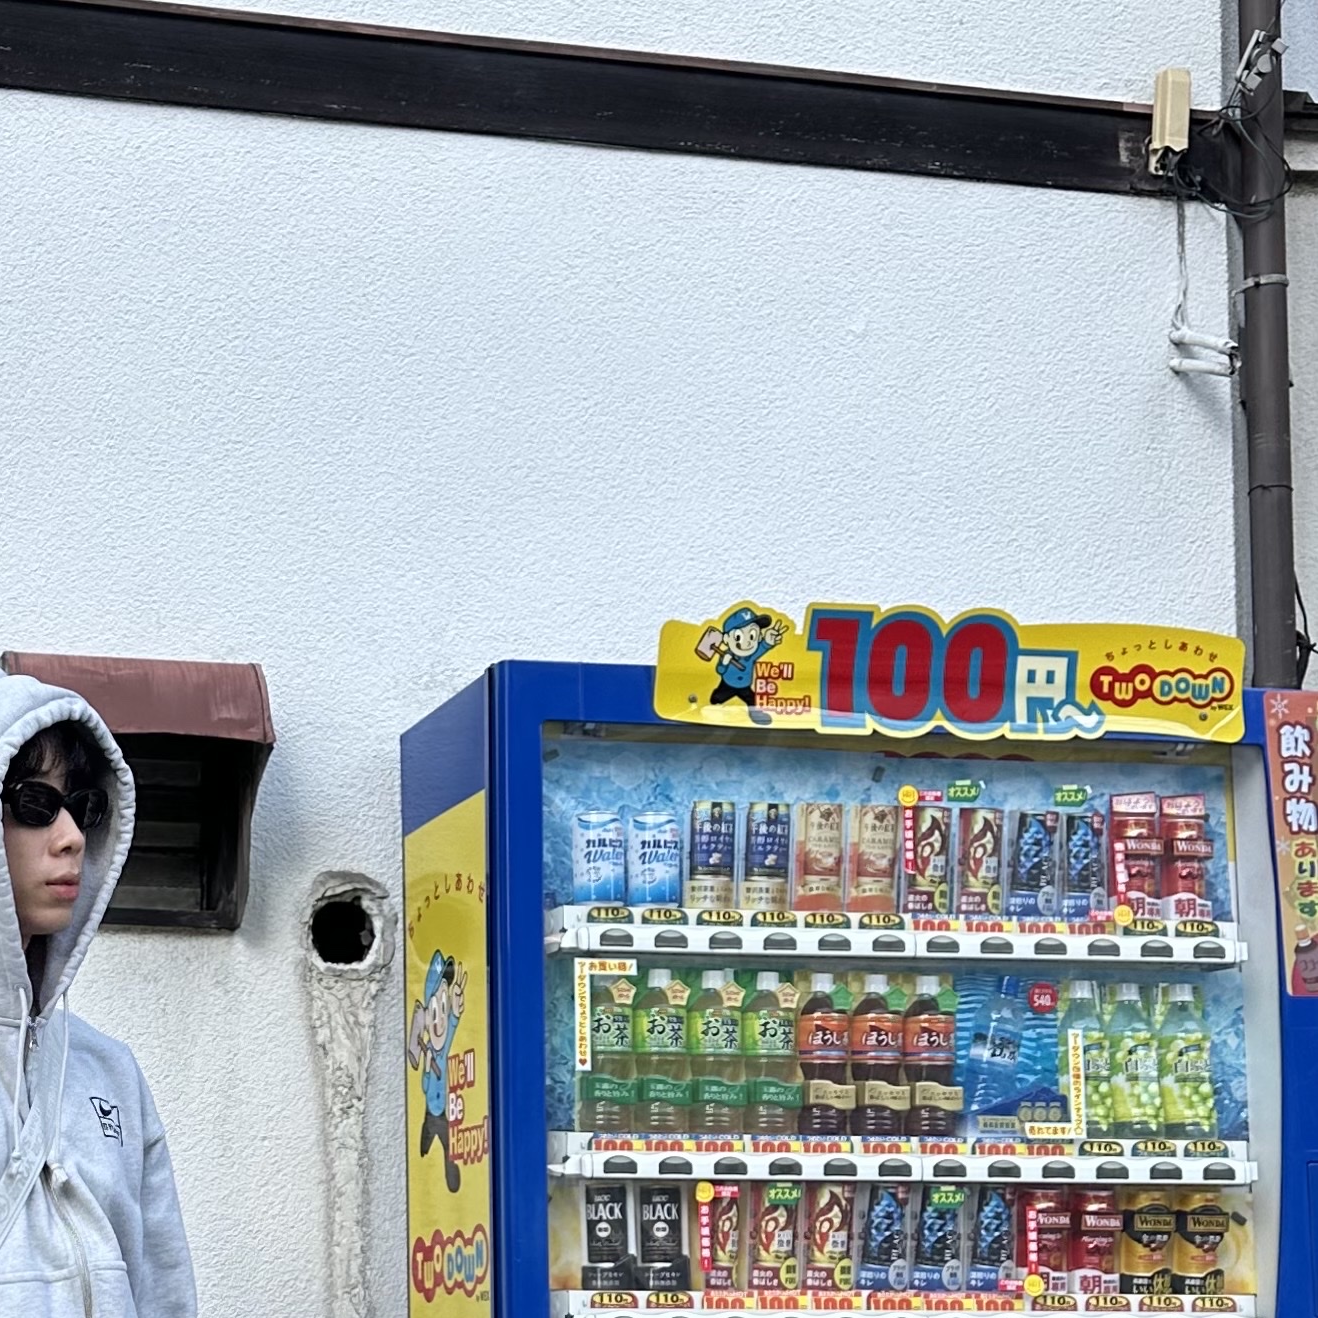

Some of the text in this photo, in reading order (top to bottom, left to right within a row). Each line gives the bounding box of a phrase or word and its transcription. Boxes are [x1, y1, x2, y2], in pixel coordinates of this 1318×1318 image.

[1105, 639, 1219, 663] ちょっとしあわせ
[755, 662, 794, 680] We'll
[755, 679, 777, 695] Be
[755, 695, 811, 714] Happy!
[1278, 724, 1318, 833] 飲み物
[1176, 841, 1212, 853] WONDA
[408, 871, 485, 939] ちょっとしあわせ
[448, 1052, 475, 1089] We'll
[448, 1091, 464, 1122] Be
[448, 1116, 489, 1163] Happy!
[586, 1202, 623, 1220] BLACK
[642, 1203, 679, 1220] BLACK
[1085, 1215, 1121, 1227] WONDA
[1139, 1215, 1172, 1227] WONDA
[1191, 1216, 1226, 1228] WONDA
